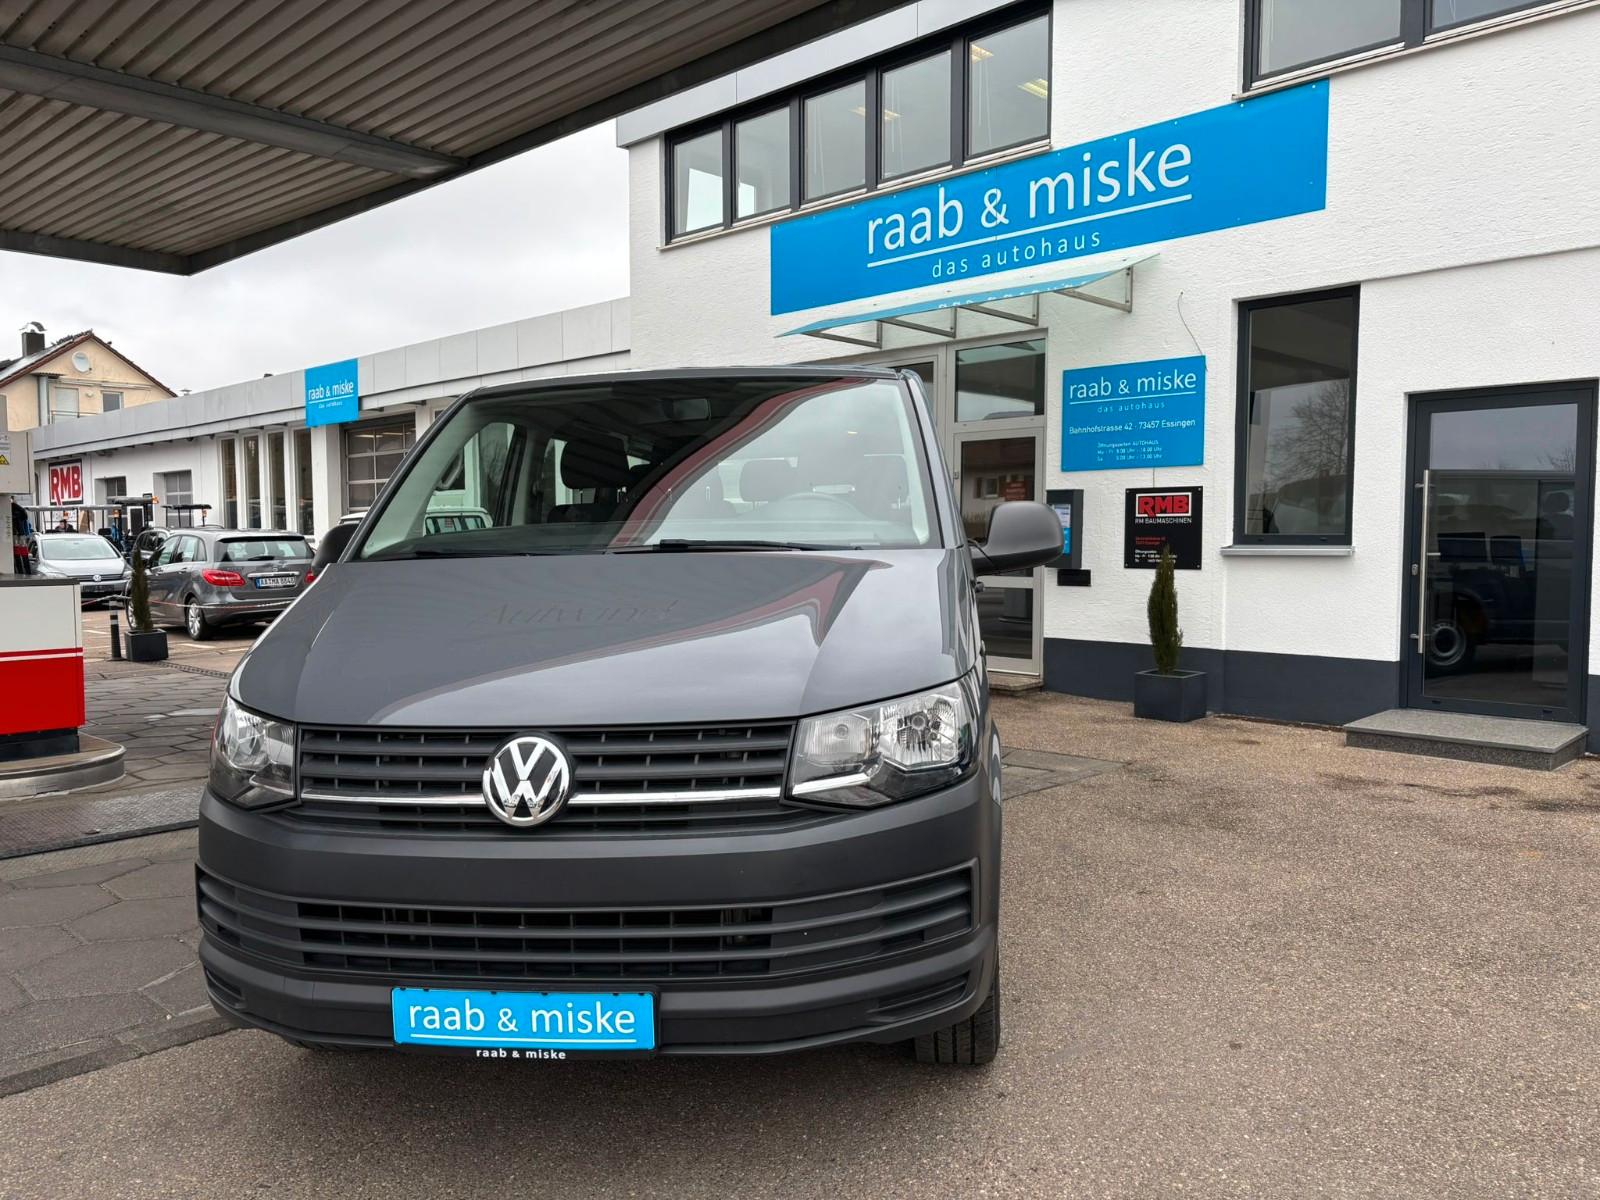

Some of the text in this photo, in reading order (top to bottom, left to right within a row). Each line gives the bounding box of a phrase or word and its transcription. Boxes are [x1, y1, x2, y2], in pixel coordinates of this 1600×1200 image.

[867, 137, 1192, 255] raab & miske
[931, 231, 1101, 278] das autohaus
[308, 384, 324, 401] raab
[332, 379, 354, 396] miske
[1069, 369, 1197, 399] raab & miske
[1097, 401, 1166, 413] das autohaus
[1069, 424, 1123, 435] Bahnhofstrasse
[1124, 422, 1134, 431] 42
[1138, 420, 1160, 430] 73457
[1161, 418, 1196, 429] Essingen
[50, 464, 82, 506] RMB
[1138, 495, 1189, 517] RMB
[1134, 517, 1145, 525] RM
[408, 998, 636, 1034] raab & miske
[476, 1047, 567, 1060] raab & miske
